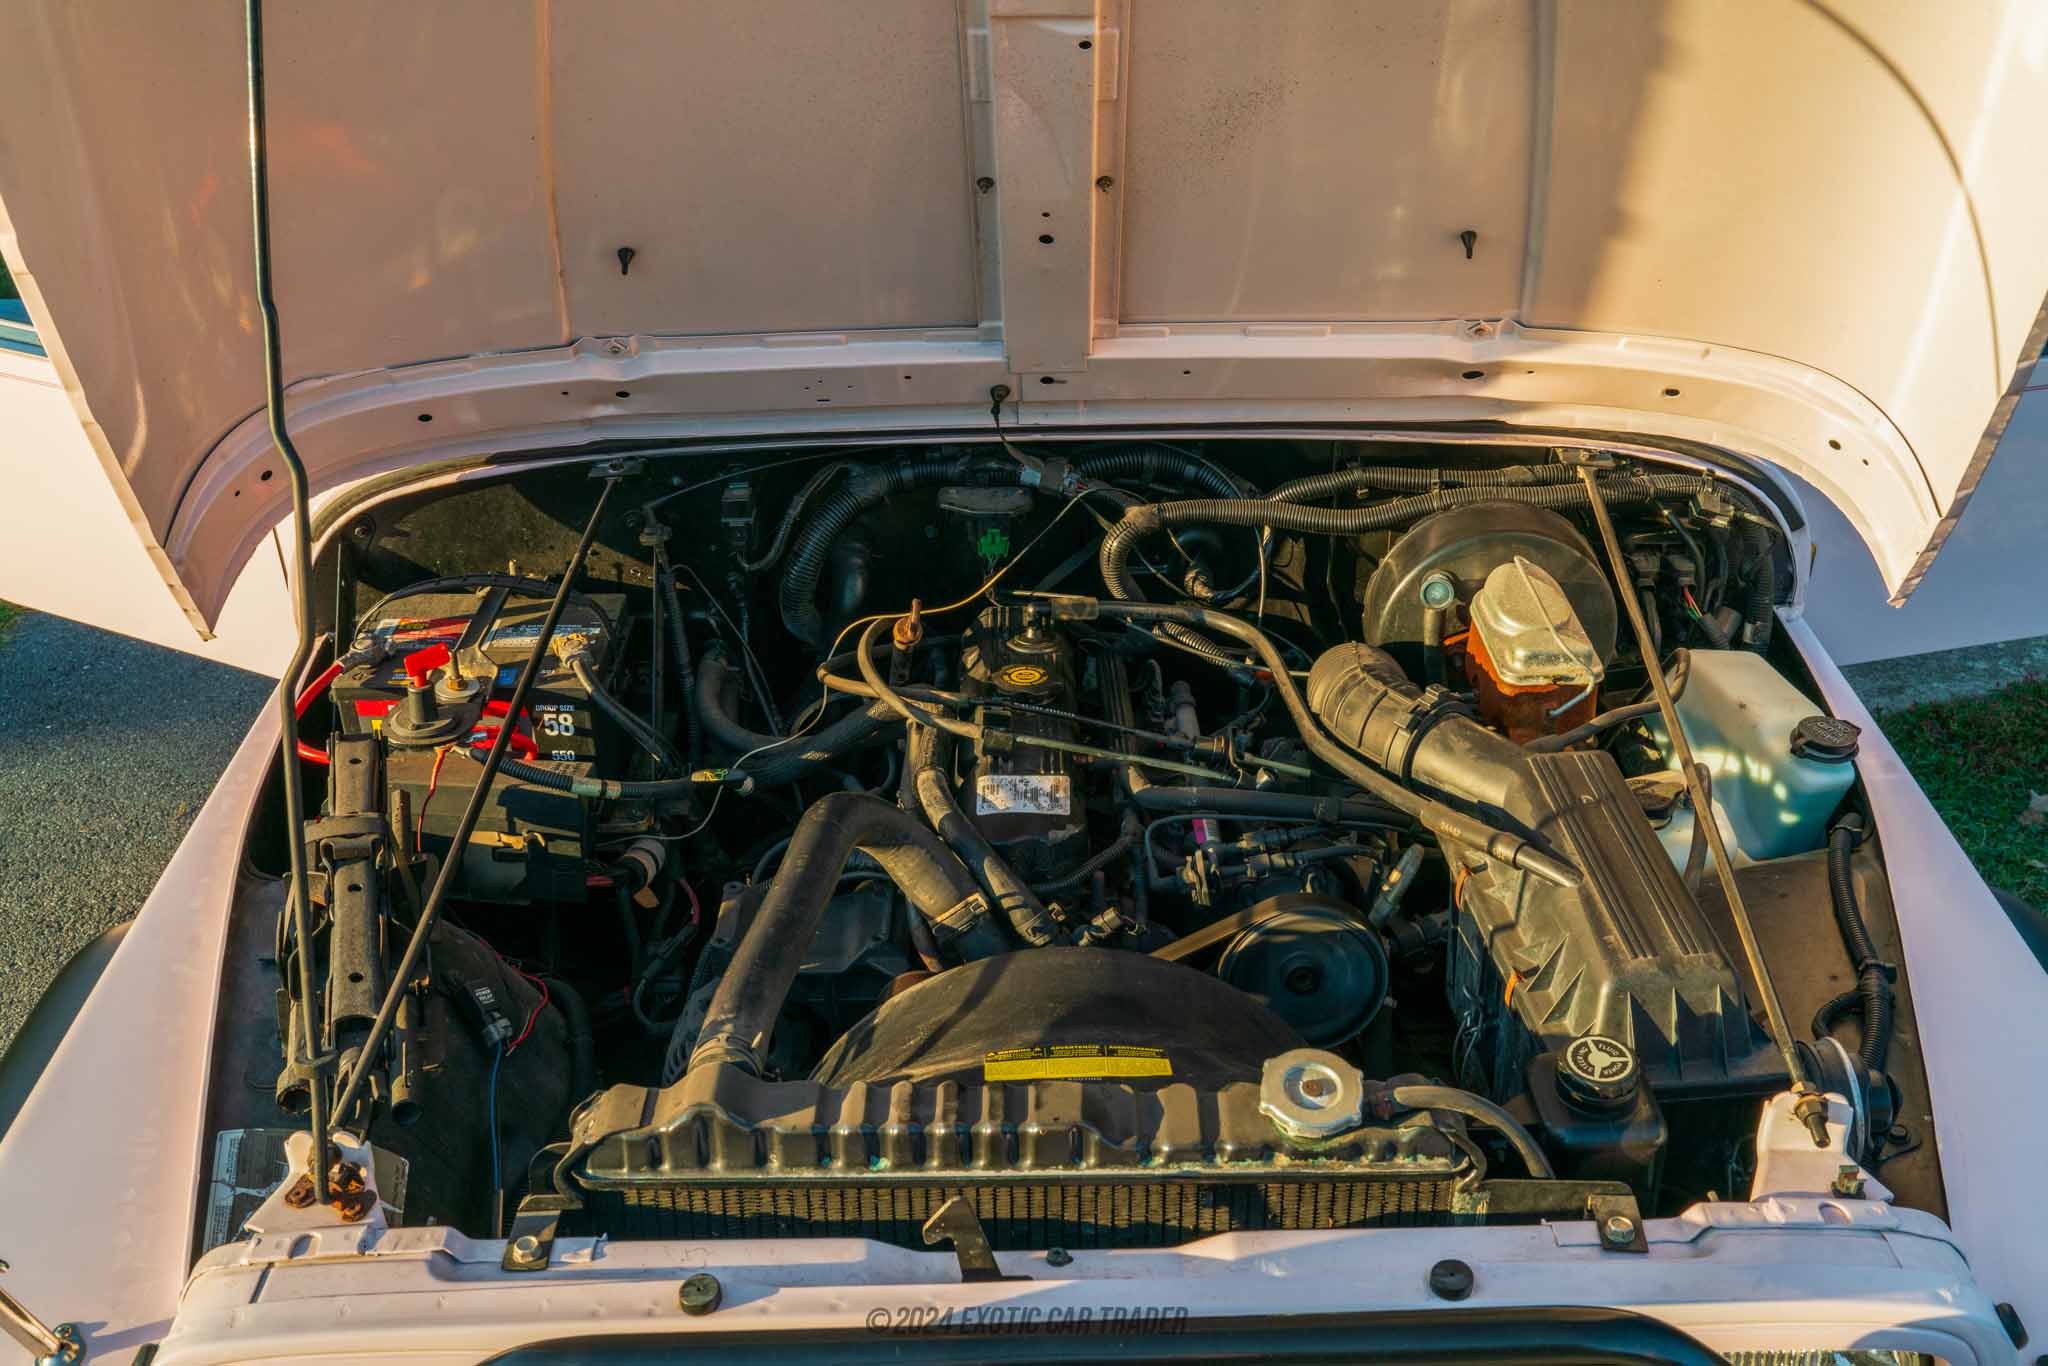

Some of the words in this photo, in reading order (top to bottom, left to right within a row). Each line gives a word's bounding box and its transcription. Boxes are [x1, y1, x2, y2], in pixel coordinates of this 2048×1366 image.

[536, 704, 558, 712] GROUP
[560, 704, 575, 712] SIZE
[543, 713, 575, 736] 58
[552, 750, 575, 760] 550
[1599, 1043, 1619, 1056] FLUID
